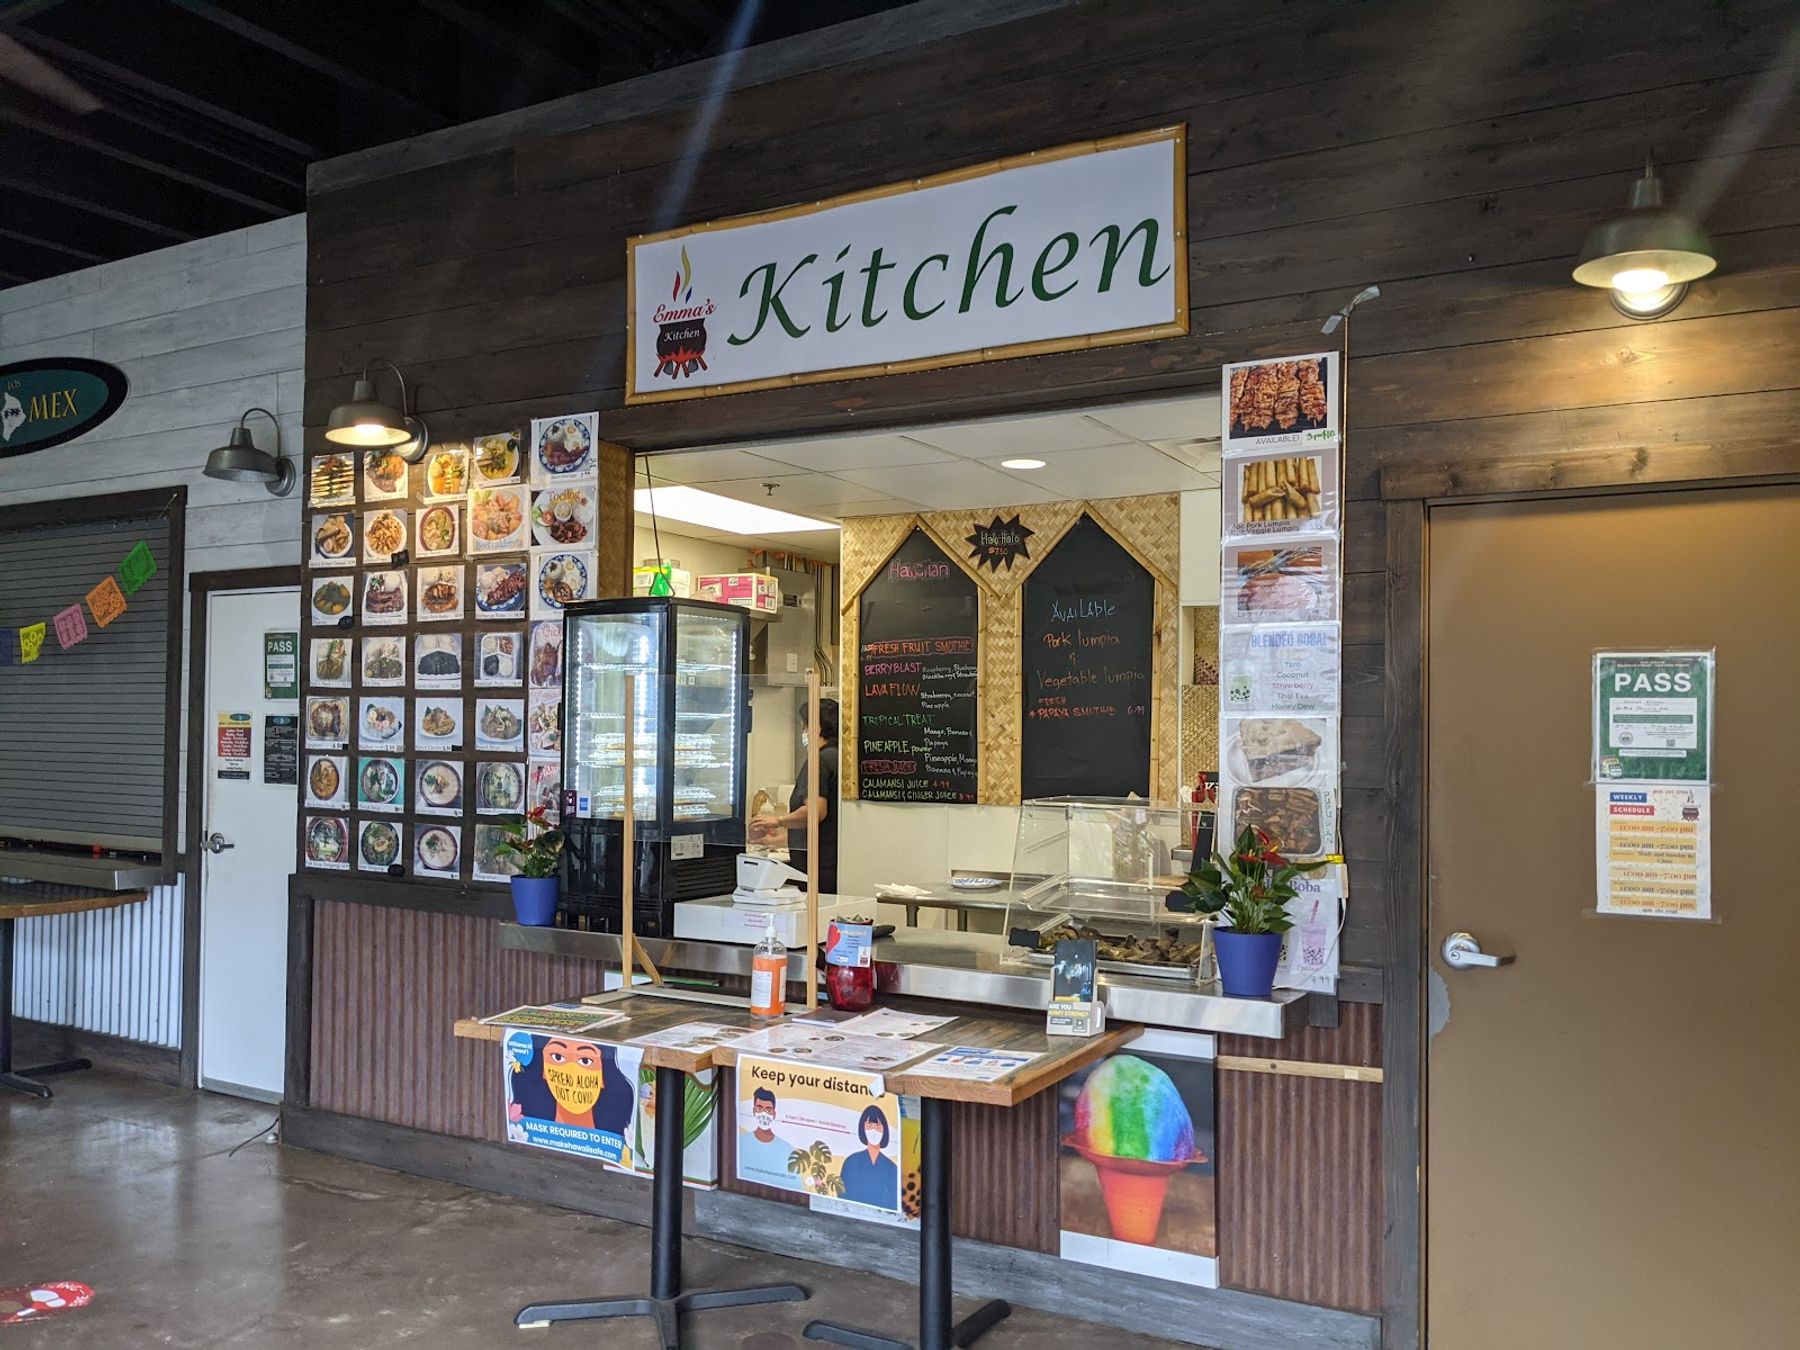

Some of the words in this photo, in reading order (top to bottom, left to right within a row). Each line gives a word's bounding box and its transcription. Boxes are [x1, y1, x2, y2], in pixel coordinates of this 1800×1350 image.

[727, 204, 1171, 346] Kitchen
[653, 298, 716, 323] Emma's
[664, 328, 700, 342] Kitchen
[29, 389, 77, 422] MEX
[268, 641, 292, 652] PASS
[902, 641, 931, 655] FRUIT
[893, 662, 922, 673] BLAST
[1037, 667, 1098, 690] Vegetable
[1276, 671, 1309, 680] Coconut
[1614, 671, 1692, 692] PASS
[865, 683, 888, 697] LAVA
[889, 683, 920, 696] FLOW
[1272, 682, 1313, 691] Strawberry
[1271, 703, 1295, 712] Honey
[1297, 703, 1315, 711] Dew
[862, 714, 903, 726] TROPICAL
[903, 713, 935, 725] TREAT
[864, 740, 910, 754] PINEAPPLE
[862, 778, 904, 789] CALAMANSI
[907, 779, 928, 788] JUICE
[1290, 880, 1321, 893] Boba
[548, 1069, 573, 1087] SPREAD
[577, 1075, 598, 1089] ALOHA
[751, 1065, 785, 1085] Keep
[788, 1073, 820, 1088] your
[823, 1076, 885, 1098] distan
[555, 1085, 569, 1101] NOT
[572, 1090, 593, 1104] COVID
[526, 1121, 548, 1133] MASK
[549, 1125, 588, 1140] REQUIRED
[589, 1133, 600, 1142] TO
[601, 1134, 622, 1150] ENTER
[532, 1136, 617, 1160] www.makehawaiisafe.com
